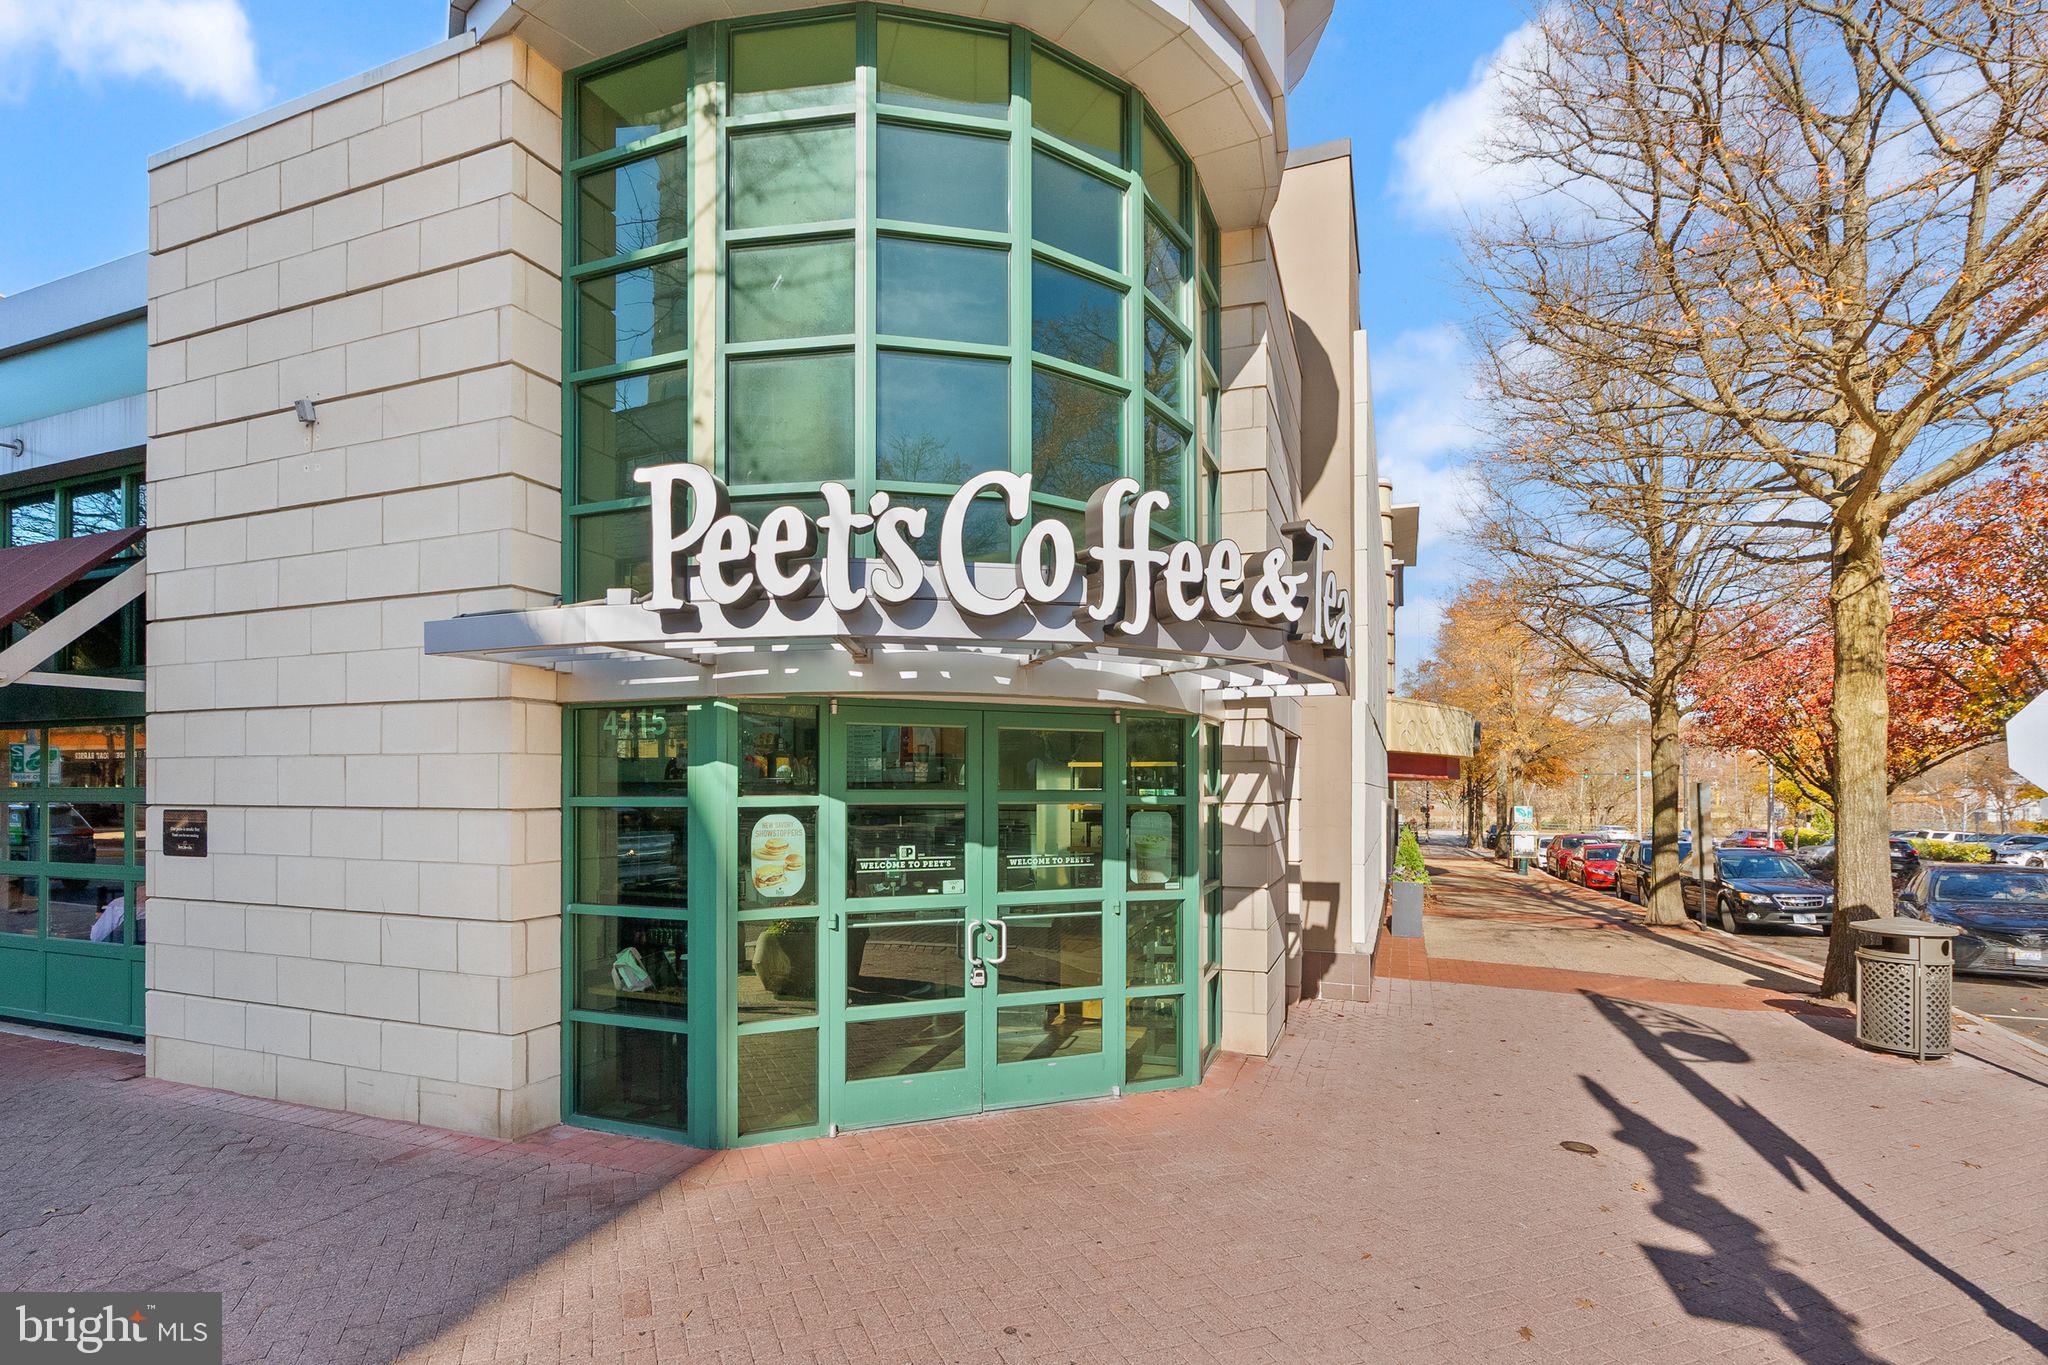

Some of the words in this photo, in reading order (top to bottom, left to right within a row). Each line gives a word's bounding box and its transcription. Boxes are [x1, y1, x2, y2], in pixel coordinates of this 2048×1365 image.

[632, 462, 928, 613] Peet's
[941, 470, 1244, 636] Coffee
[1251, 547, 1309, 622] &
[1305, 520, 1353, 658] Tea
[602, 708, 667, 739] 4115
[860, 861, 906, 870] WELCOME
[923, 859, 952, 868] PEET'S
[1009, 857, 1050, 866] WELCOME
